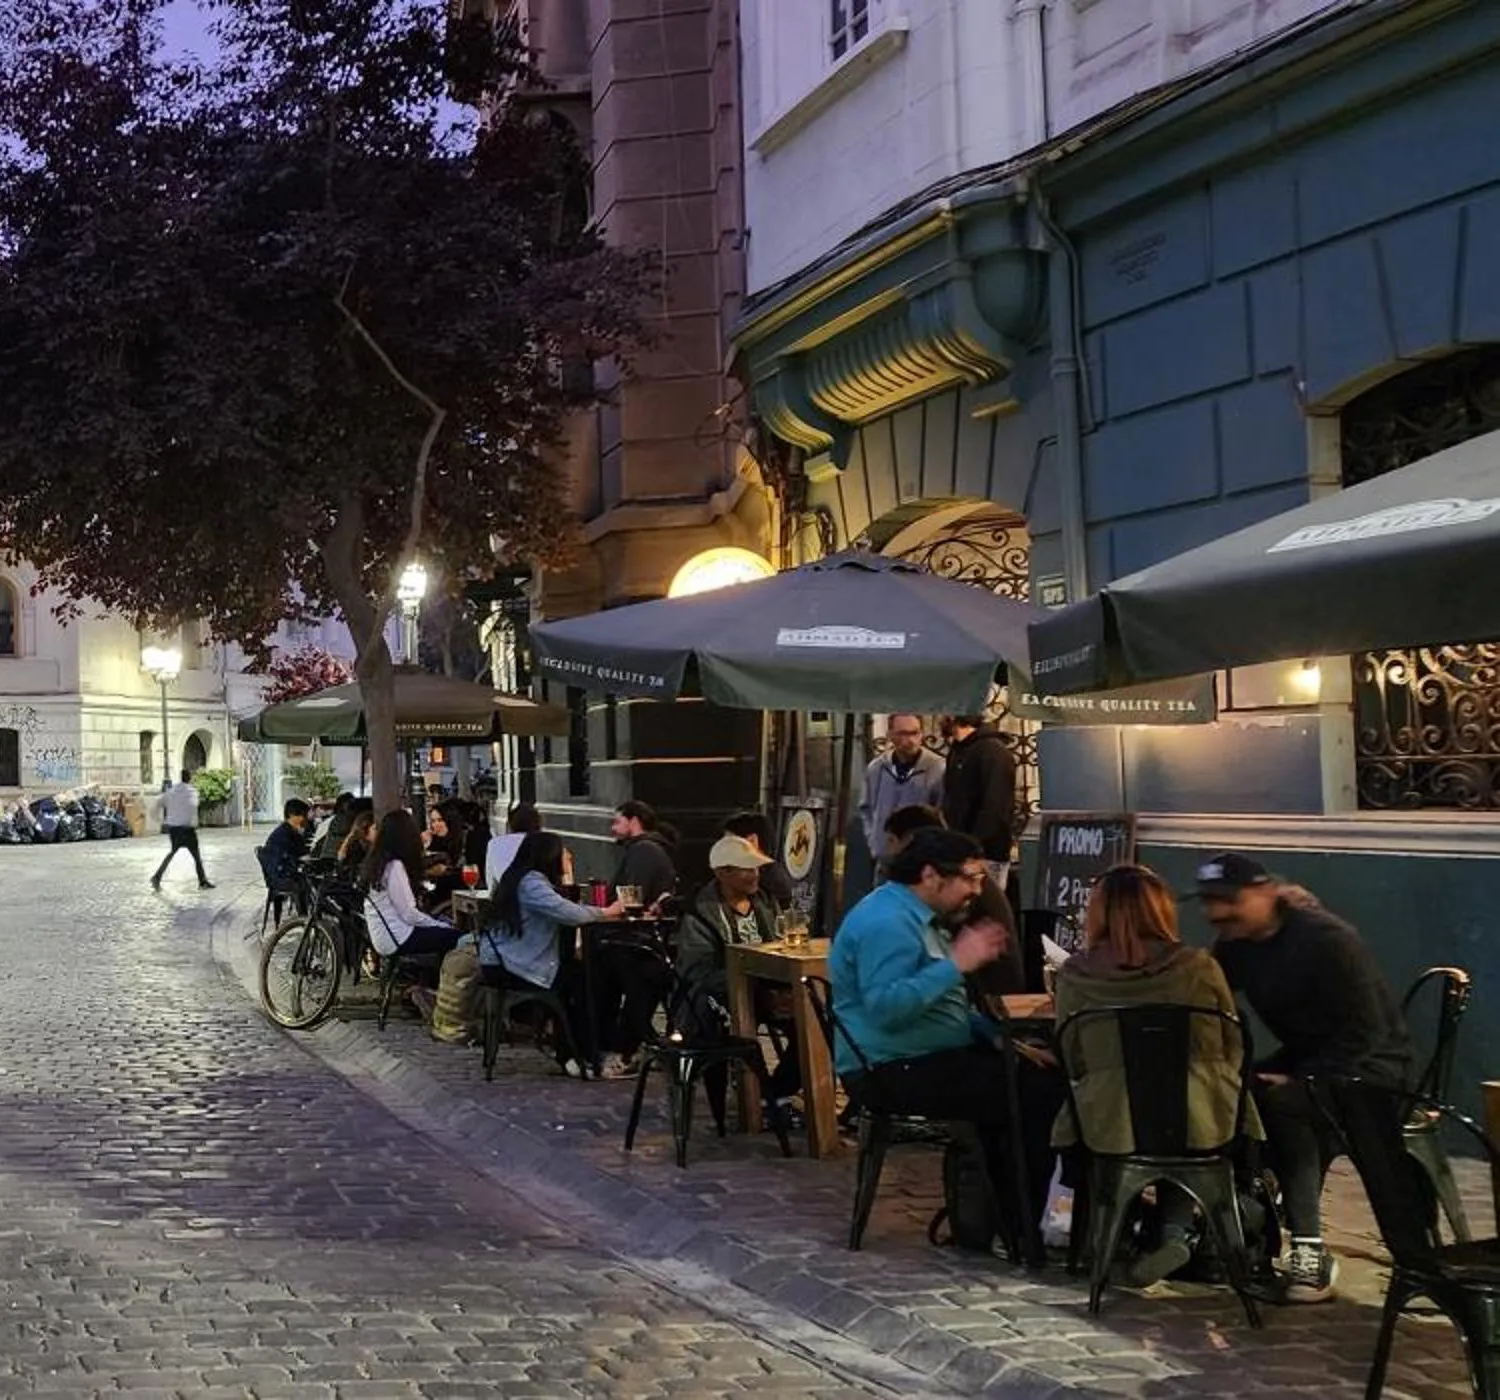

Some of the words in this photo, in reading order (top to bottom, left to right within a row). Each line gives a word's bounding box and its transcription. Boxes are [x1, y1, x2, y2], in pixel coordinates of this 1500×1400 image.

[597, 666, 644, 685] QUALITY
[1100, 699, 1161, 713] QUALITY
[1167, 701, 1197, 712] TEA
[1058, 826, 1104, 856] PROMO
[1057, 876, 1070, 907] 2
